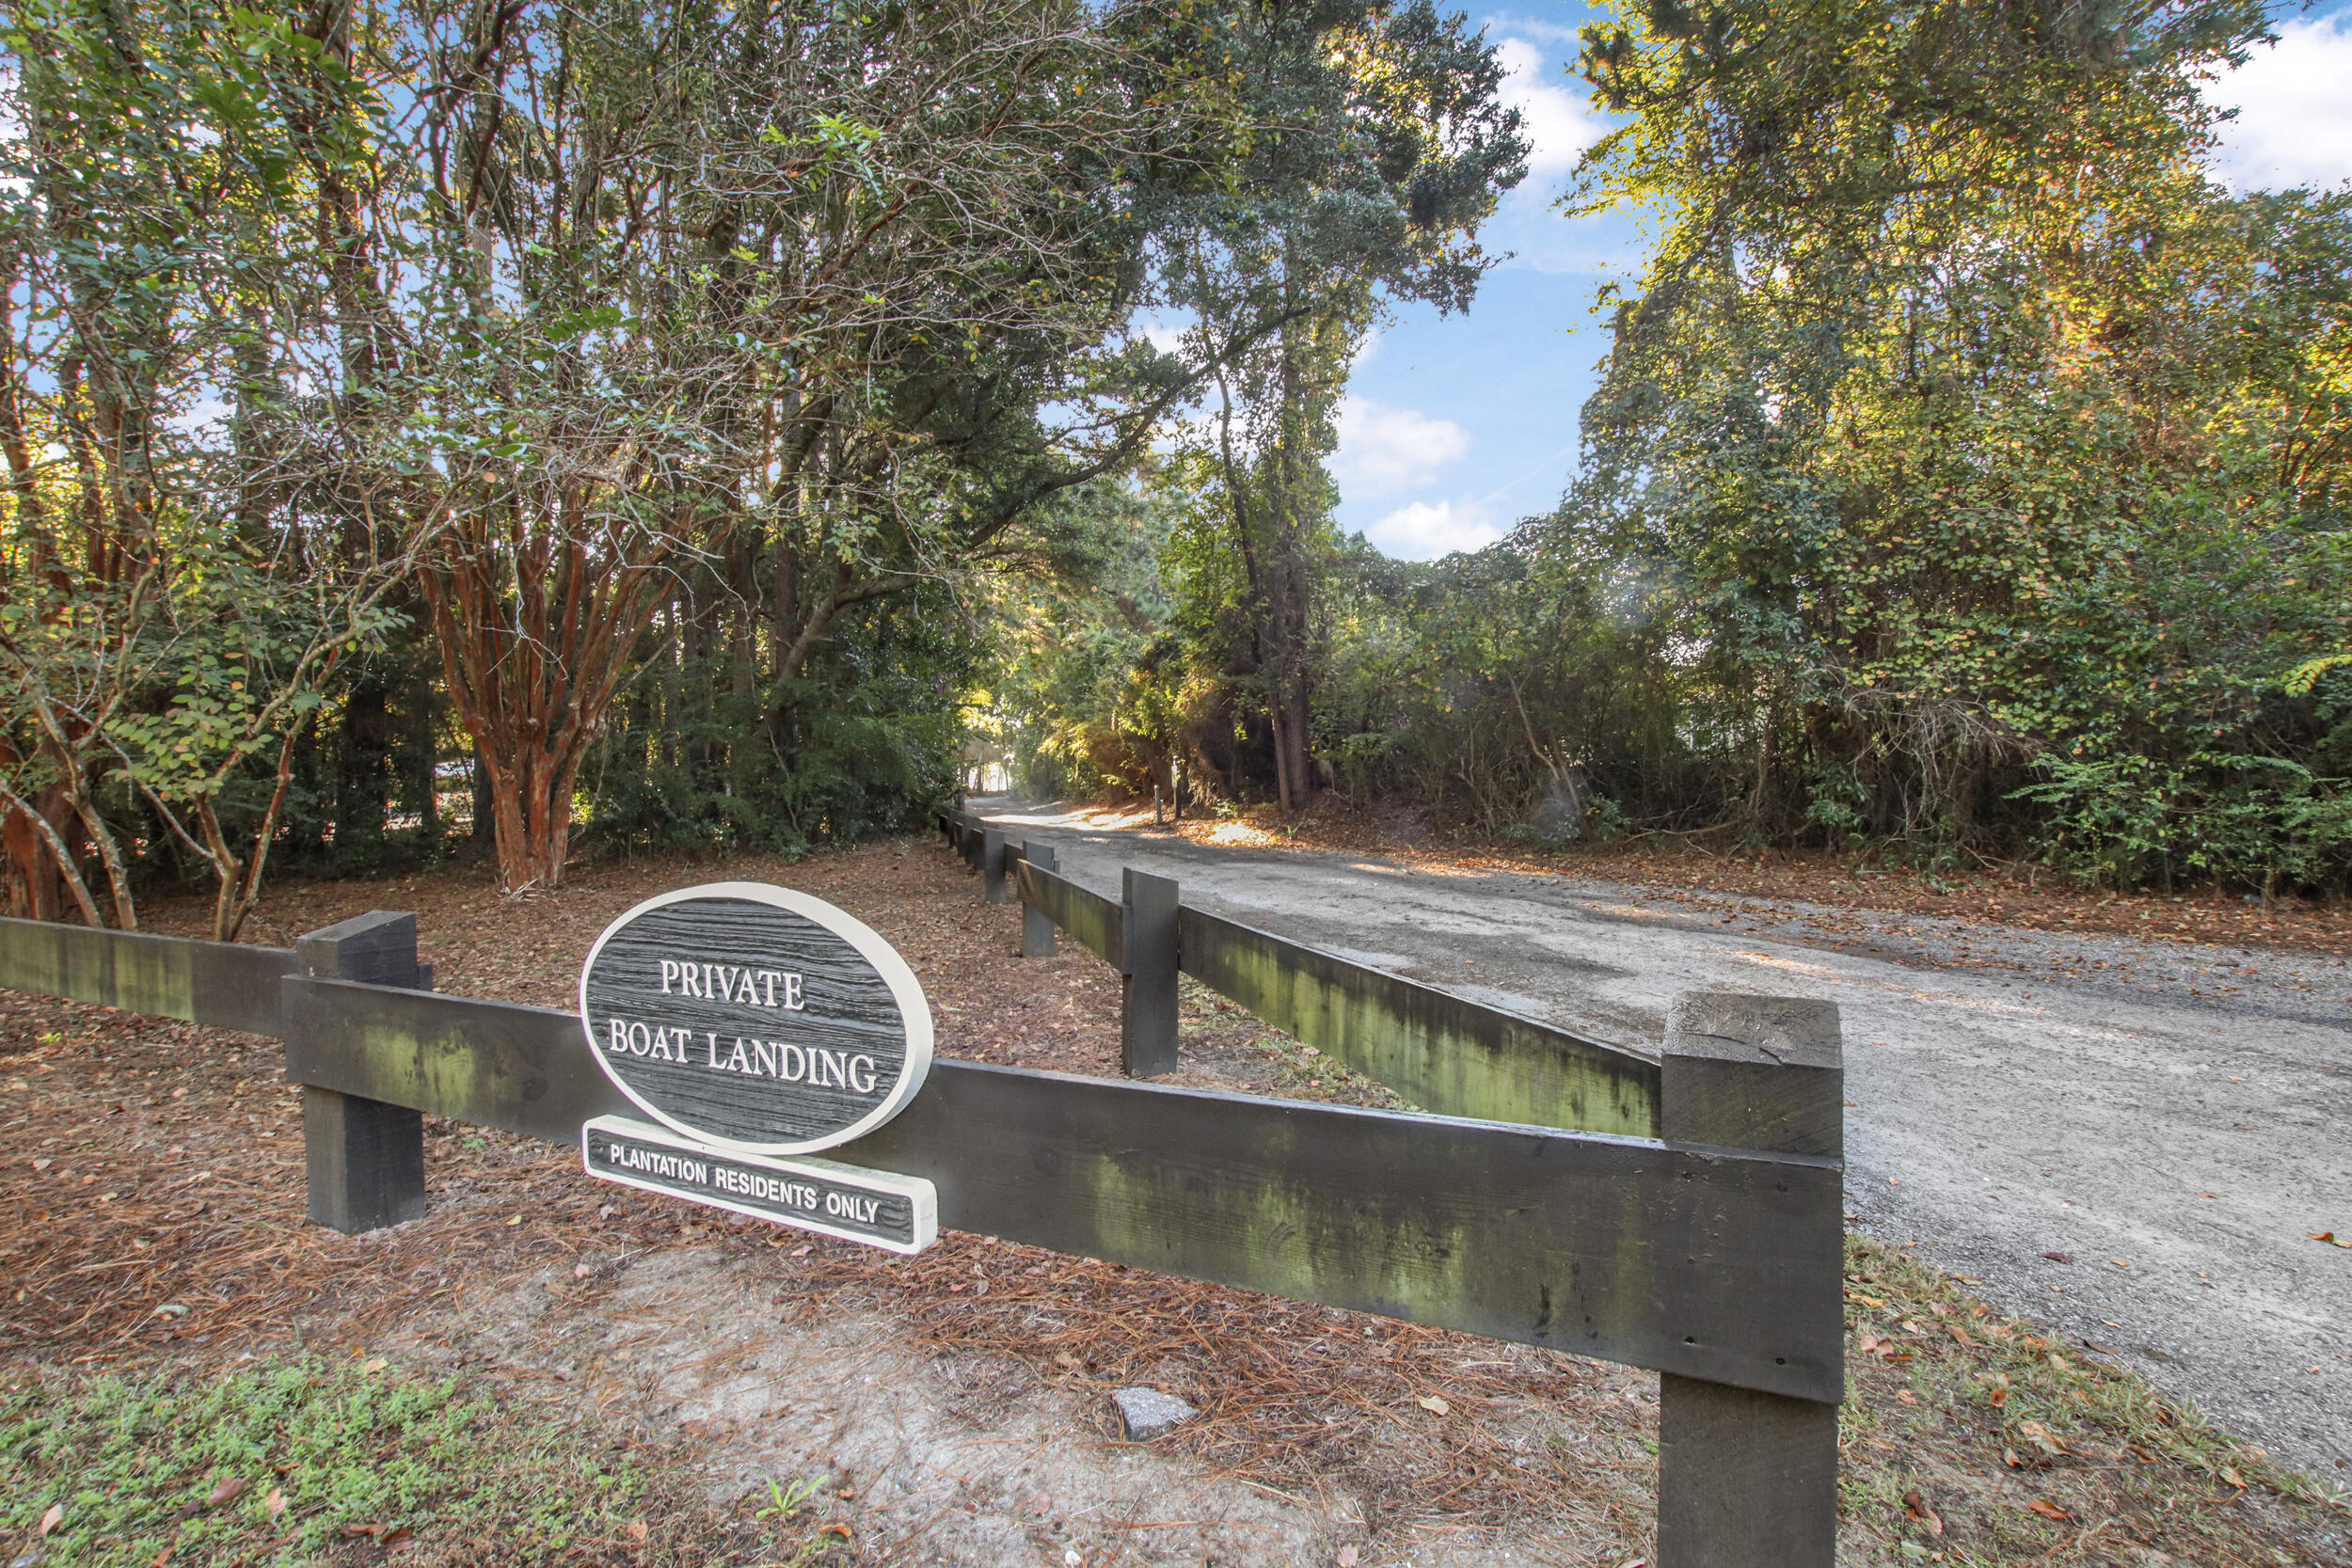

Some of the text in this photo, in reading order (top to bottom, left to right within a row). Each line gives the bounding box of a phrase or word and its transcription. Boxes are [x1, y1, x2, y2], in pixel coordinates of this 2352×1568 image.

[660, 959, 805, 1011] PRIVATE
[609, 1018, 877, 1094] BOAT LANDING
[610, 1143, 879, 1224] PLANTATION RESIDENTS ONLY
